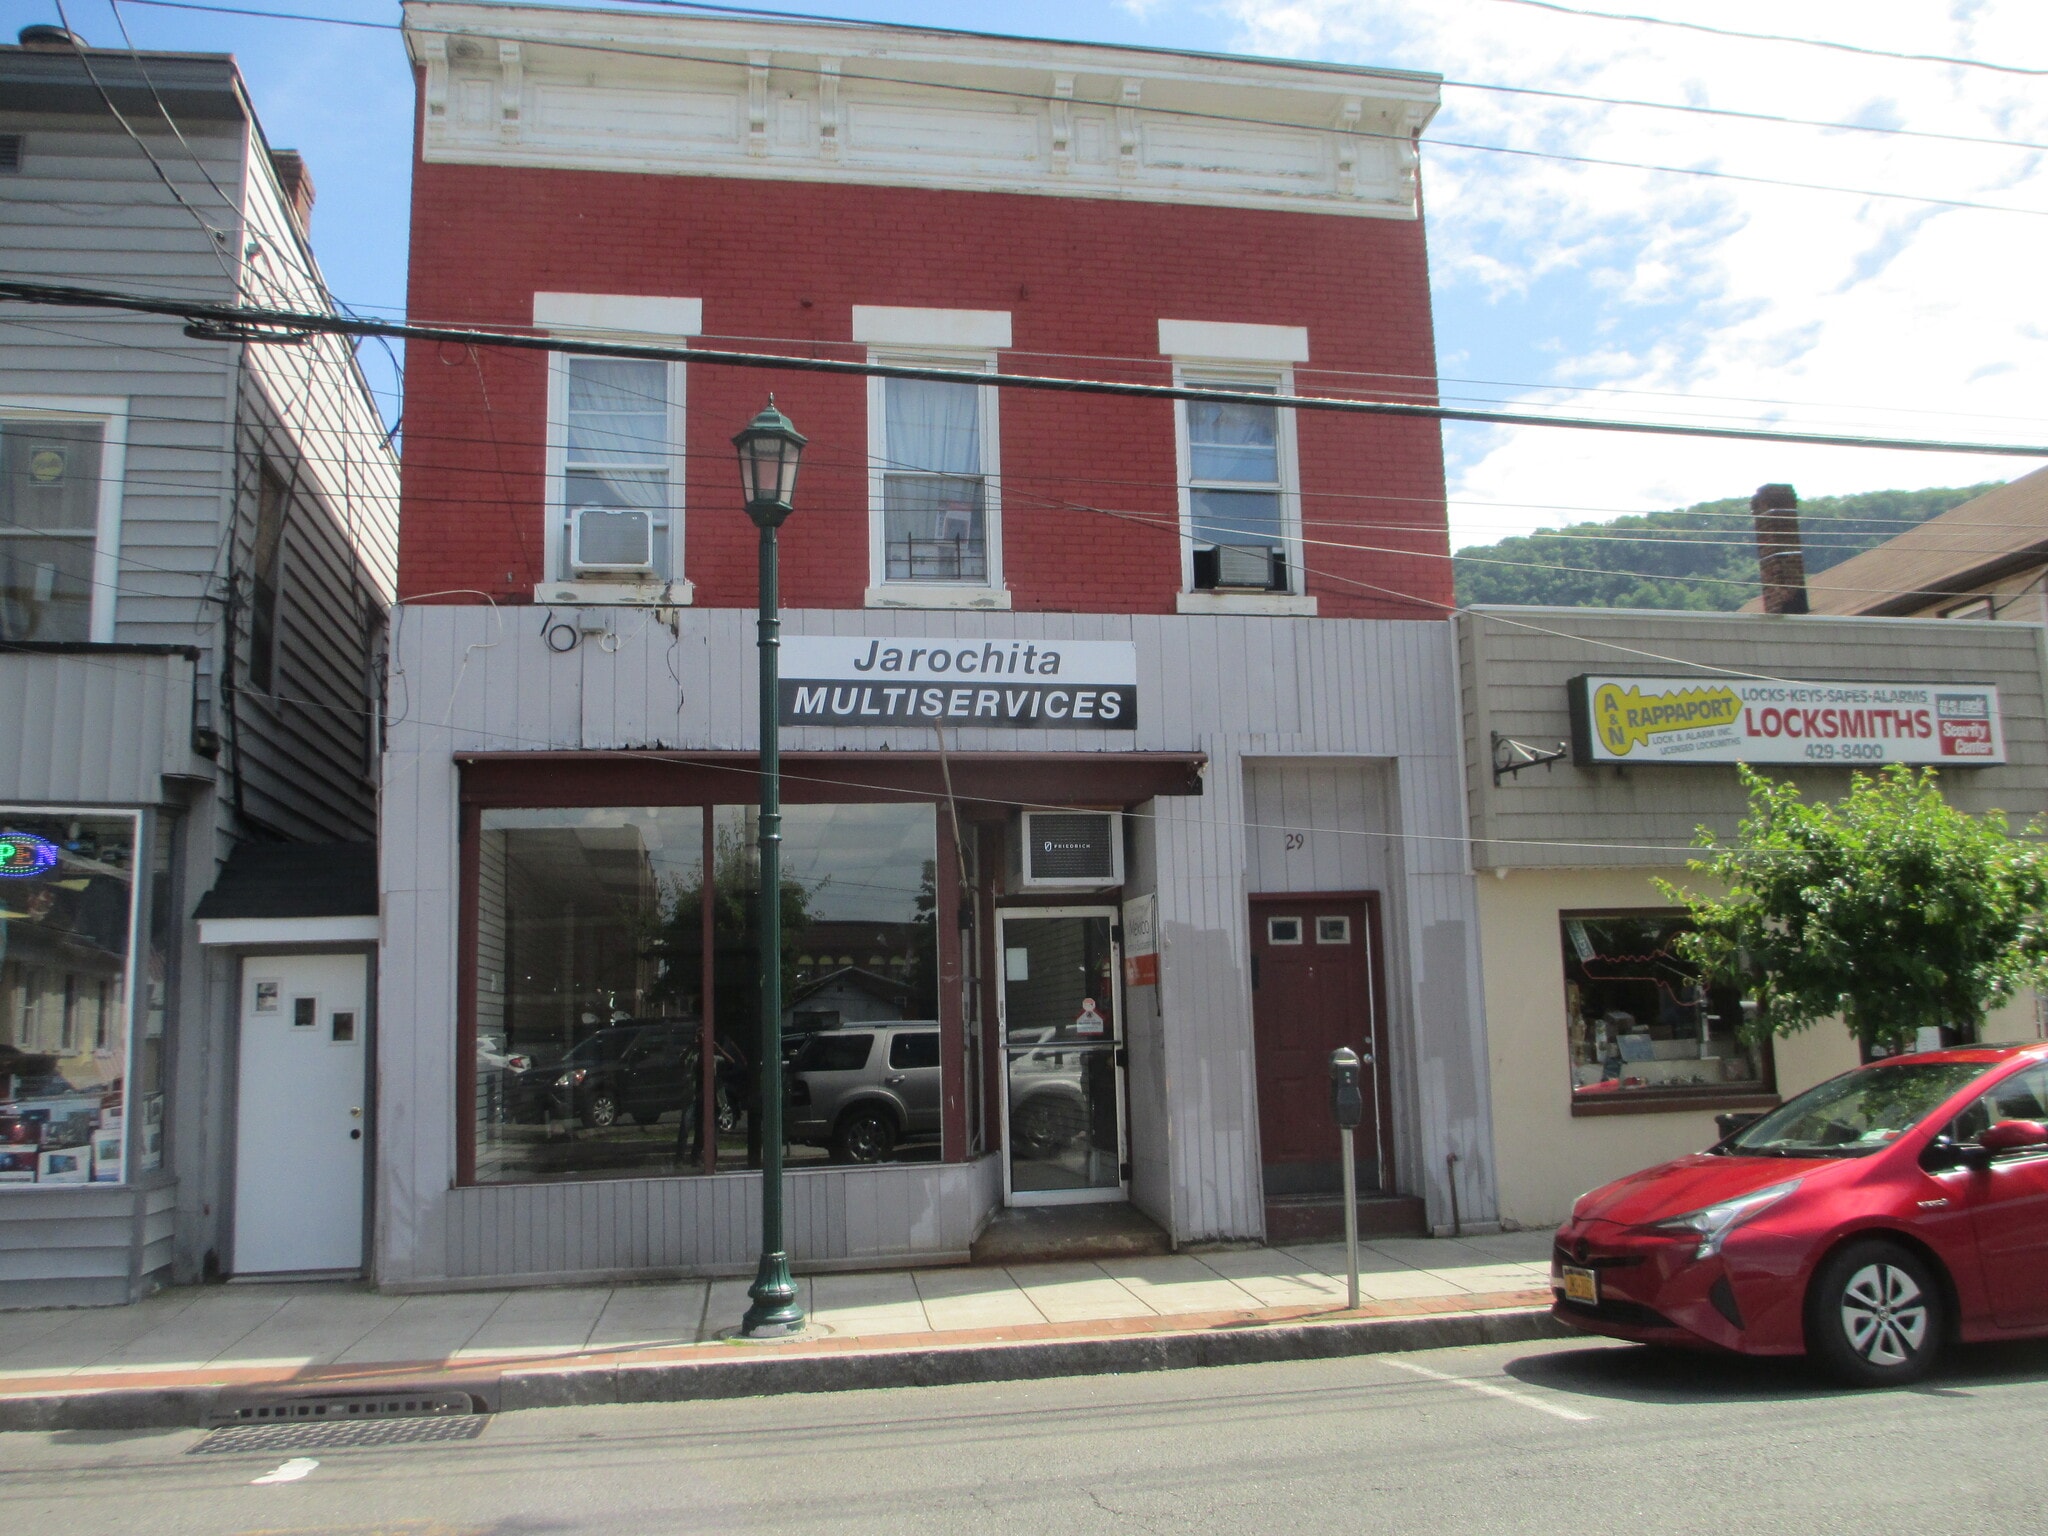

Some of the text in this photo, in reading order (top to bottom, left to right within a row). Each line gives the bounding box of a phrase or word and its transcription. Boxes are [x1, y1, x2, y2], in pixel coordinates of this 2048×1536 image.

[853, 640, 1061, 675] Jarochita
[793, 686, 1122, 719] MULTISERVICES
[1627, 698, 1733, 728] RAPPAPORT
[1744, 707, 1932, 739] LOCKSMITHS
[1943, 722, 1987, 739] Security
[1652, 735, 1674, 745] LOCK
[1685, 730, 1715, 741] ALARM
[1660, 737, 1741, 755] LICENSED LOCKSMITHS
[1805, 743, 1884, 759] 429-8400
[1286, 833, 1304, 850] 29
